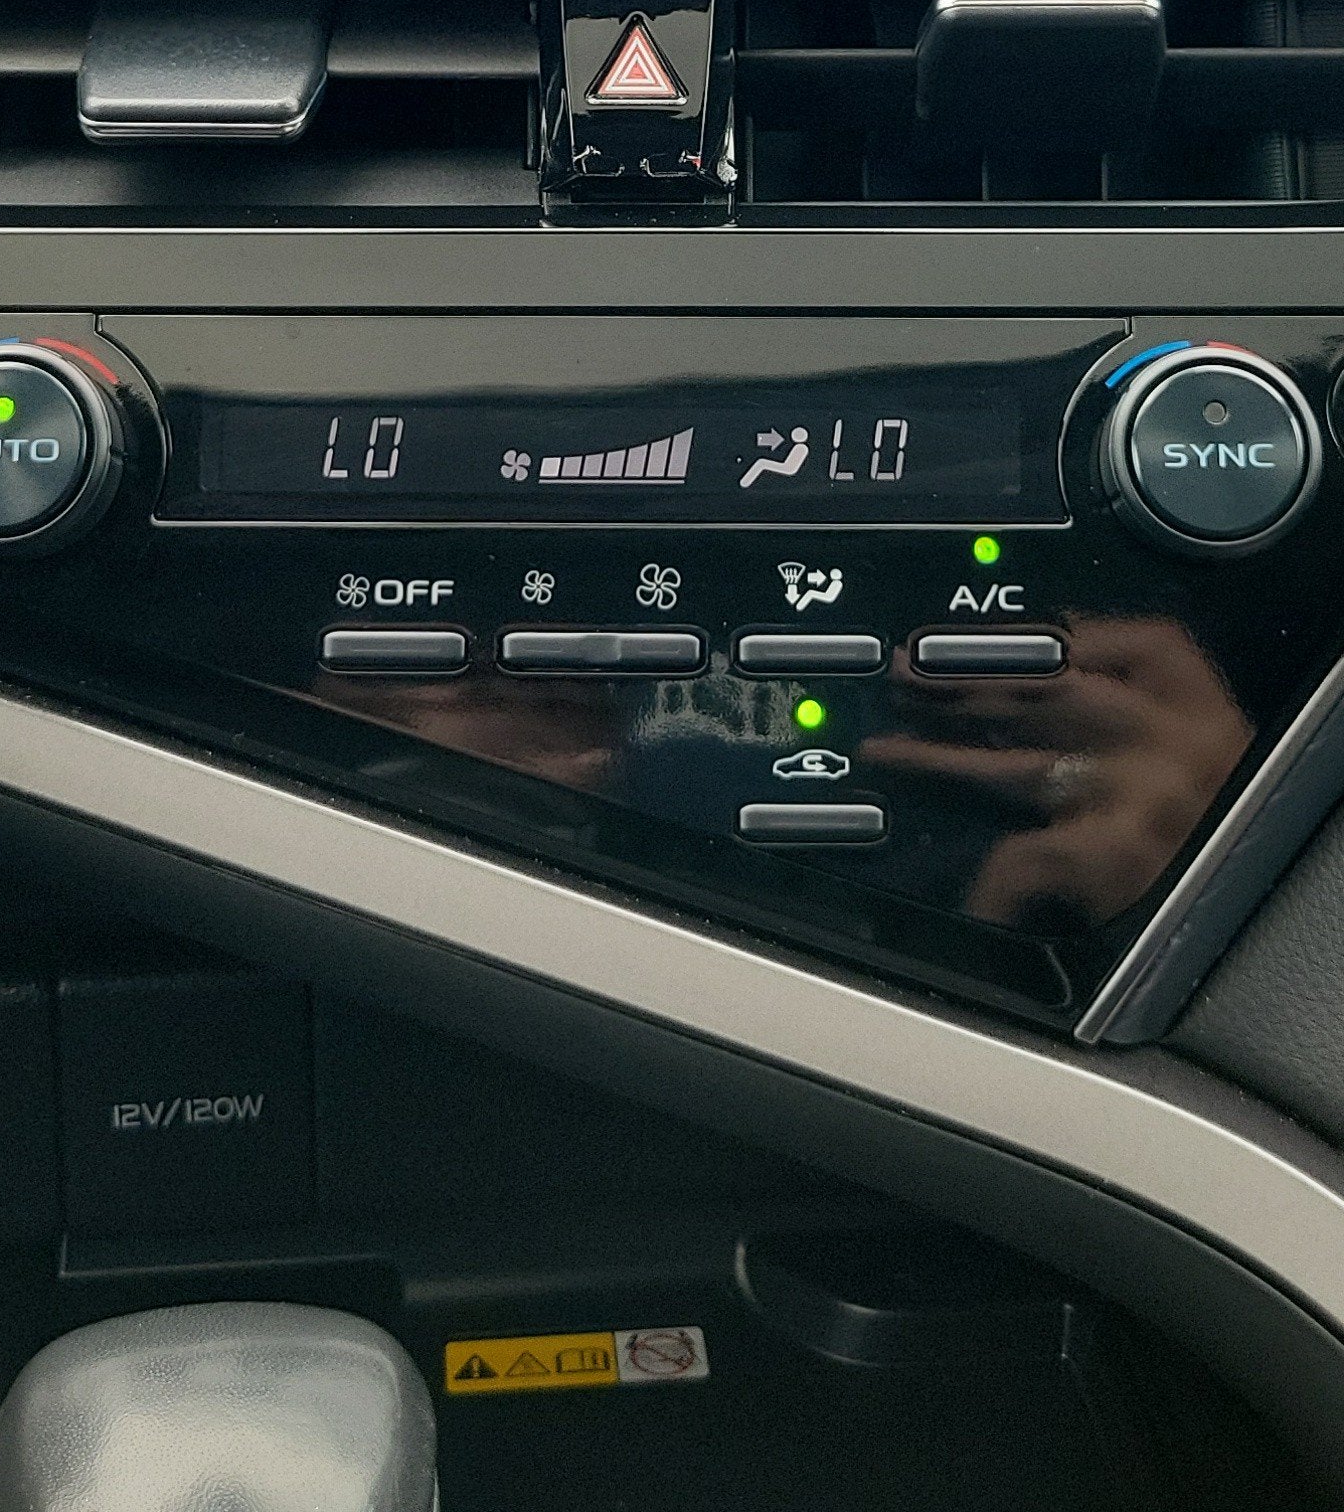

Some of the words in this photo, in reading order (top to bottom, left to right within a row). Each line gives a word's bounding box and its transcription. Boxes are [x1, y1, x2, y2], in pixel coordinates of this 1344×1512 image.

[323, 416, 404, 480] LO
[830, 419, 909, 481] LO
[1163, 443, 1276, 468] SYNC
[374, 579, 455, 606] OFF
[949, 584, 1025, 612] A/C
[113, 1094, 264, 1129] 12V/120W
